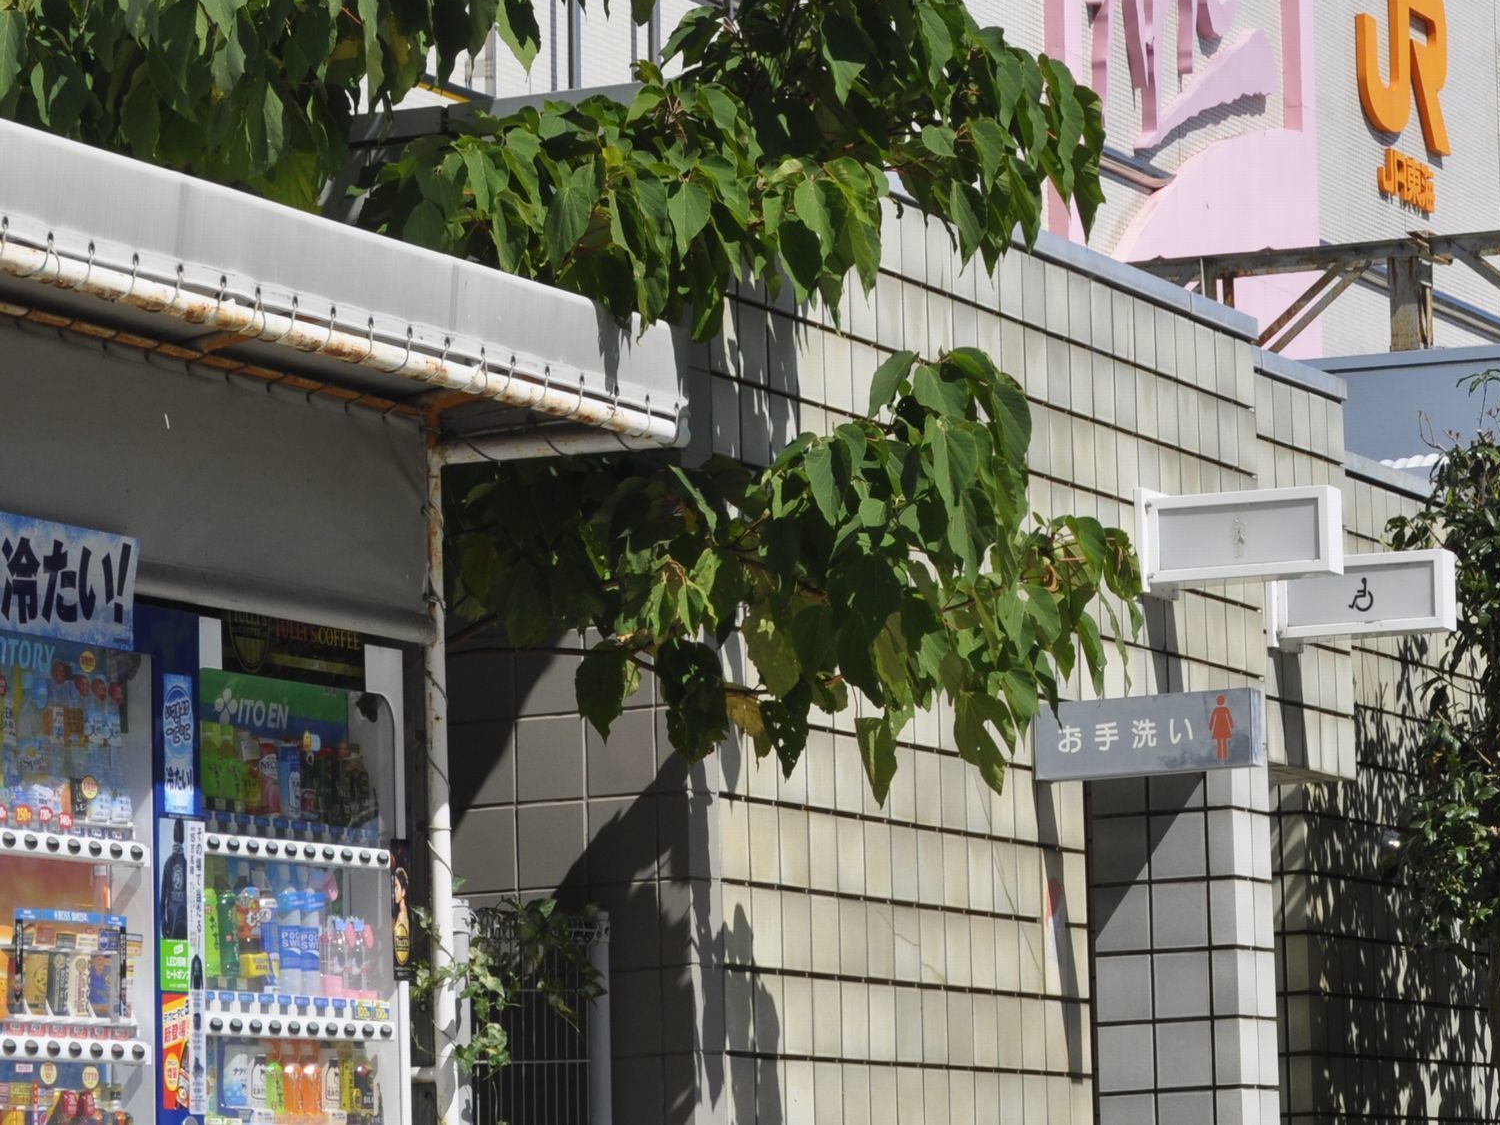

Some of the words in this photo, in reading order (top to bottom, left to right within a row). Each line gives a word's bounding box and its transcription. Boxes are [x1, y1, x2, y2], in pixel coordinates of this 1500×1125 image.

[1377, 147, 1436, 213] JR東海
[274, 618, 316, 642] TULLY'S
[317, 625, 360, 650] COFFEE
[237, 698, 268, 727] ITO
[268, 704, 289, 730] EN
[1057, 718, 1194, 754] お手洗い
